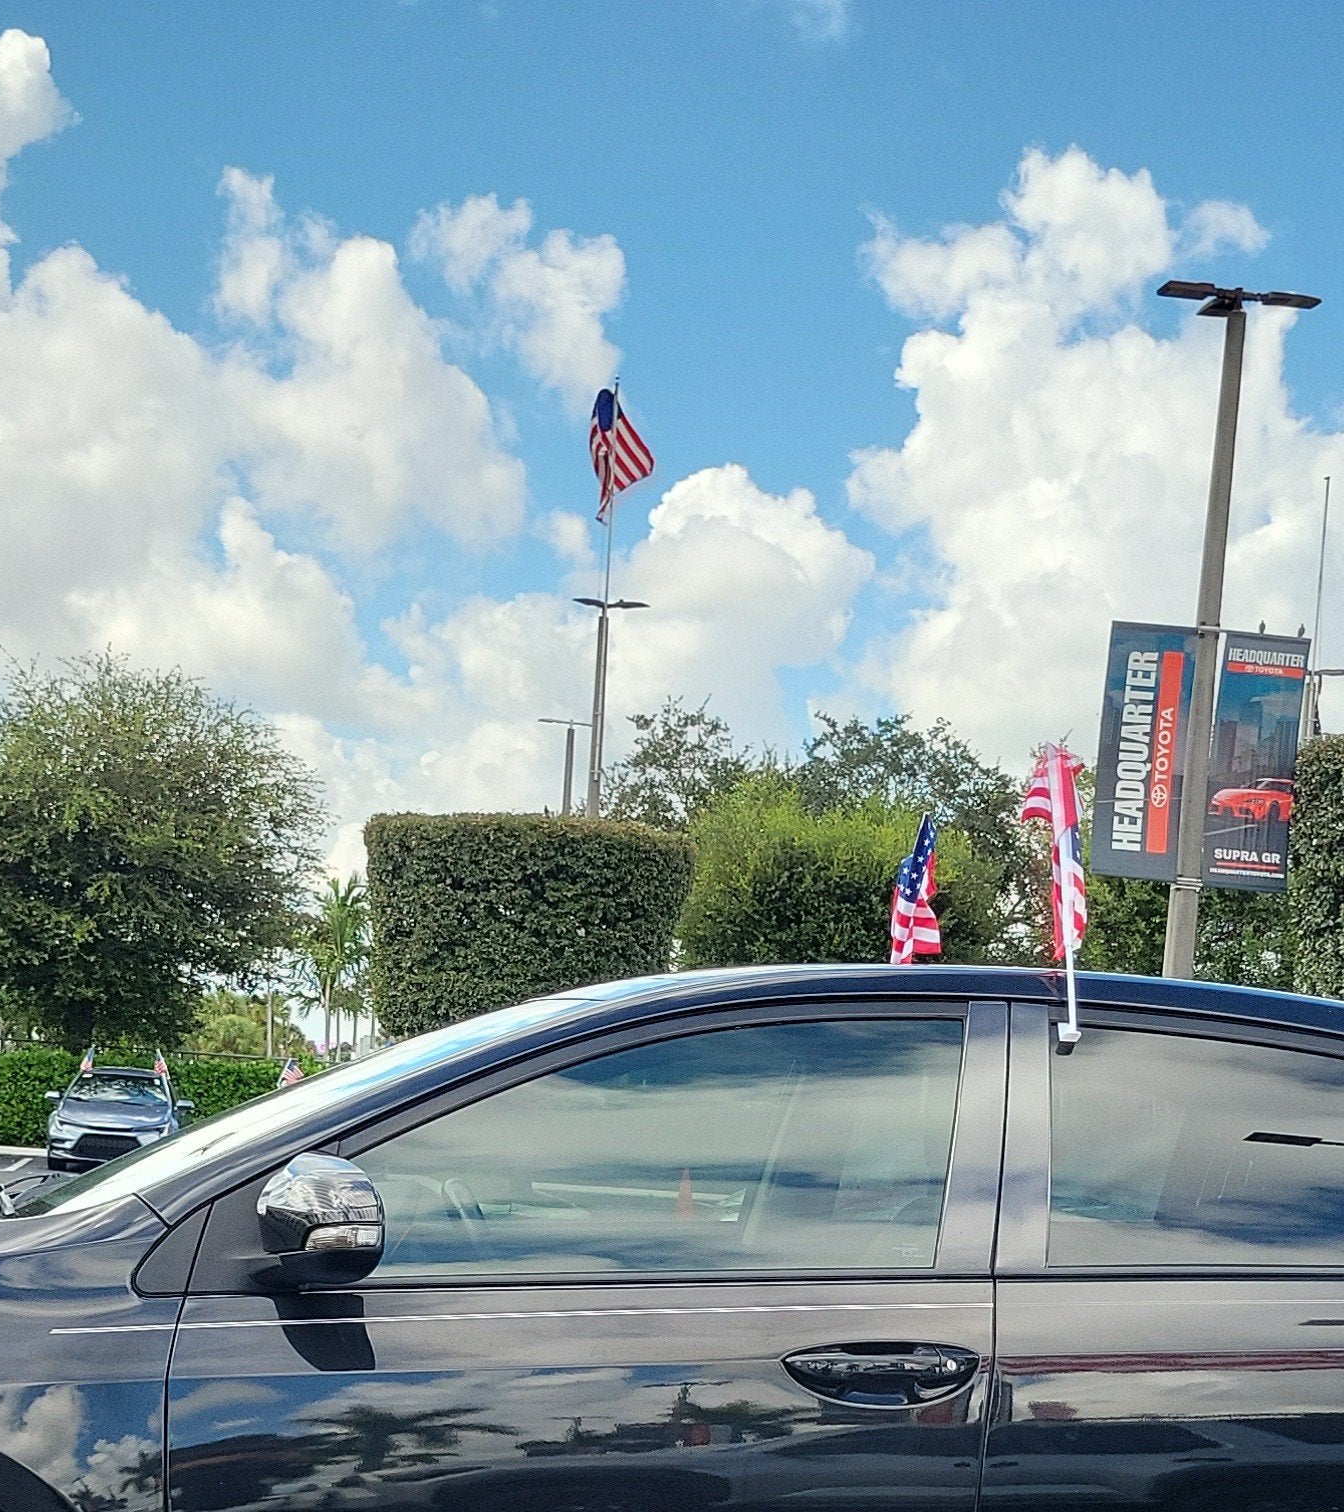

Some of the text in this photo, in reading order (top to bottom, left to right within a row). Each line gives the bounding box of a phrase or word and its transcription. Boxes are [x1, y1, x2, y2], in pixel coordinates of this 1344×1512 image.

[1228, 648, 1305, 668] HEADQUARTER
[1255, 666, 1284, 675] TOYOTA
[1112, 651, 1159, 851] HEADQUARTER
[1155, 707, 1174, 783] TOYOTA
[1214, 848, 1281, 864] SUPRA GR
